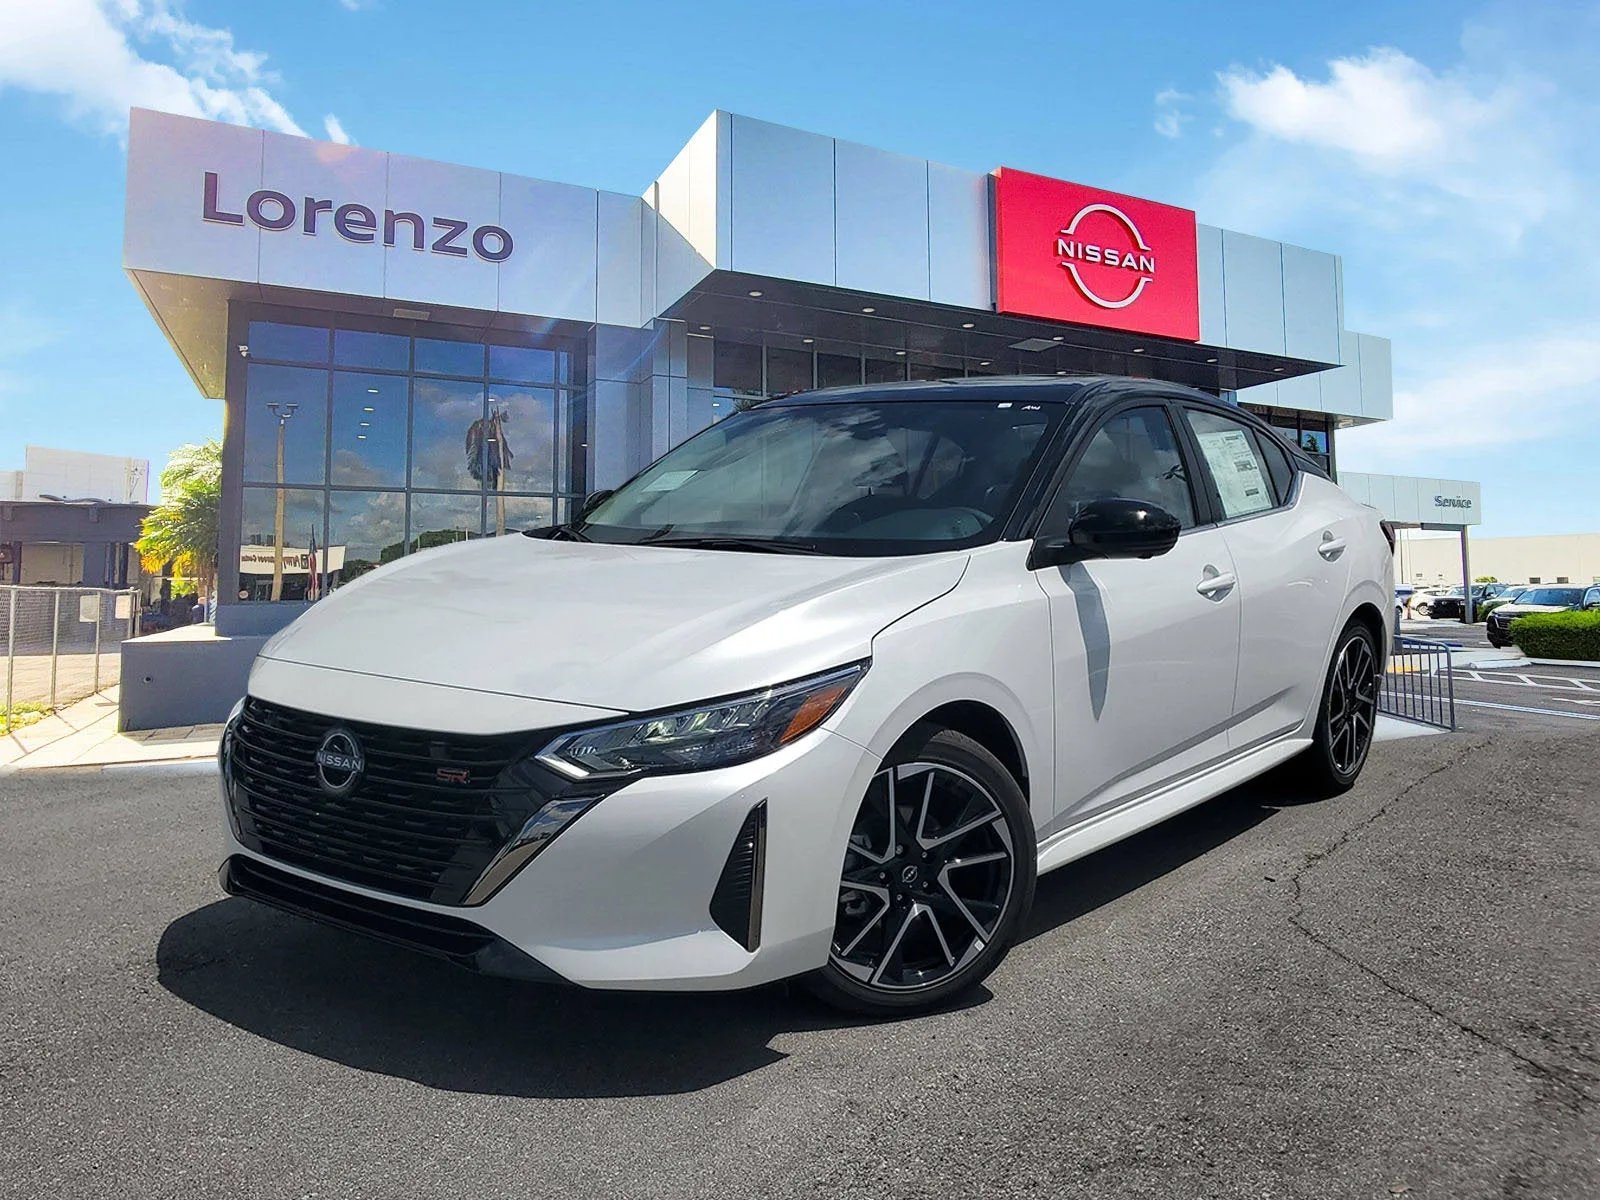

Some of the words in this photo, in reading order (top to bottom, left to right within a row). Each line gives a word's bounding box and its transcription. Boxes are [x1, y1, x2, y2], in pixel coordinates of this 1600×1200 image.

[203, 172, 513, 262] Lorenzo
[1057, 238, 1155, 273] NISSAN
[1434, 495, 1472, 508] Service
[316, 751, 362, 771] NISSAN
[437, 768, 467, 784] SR
